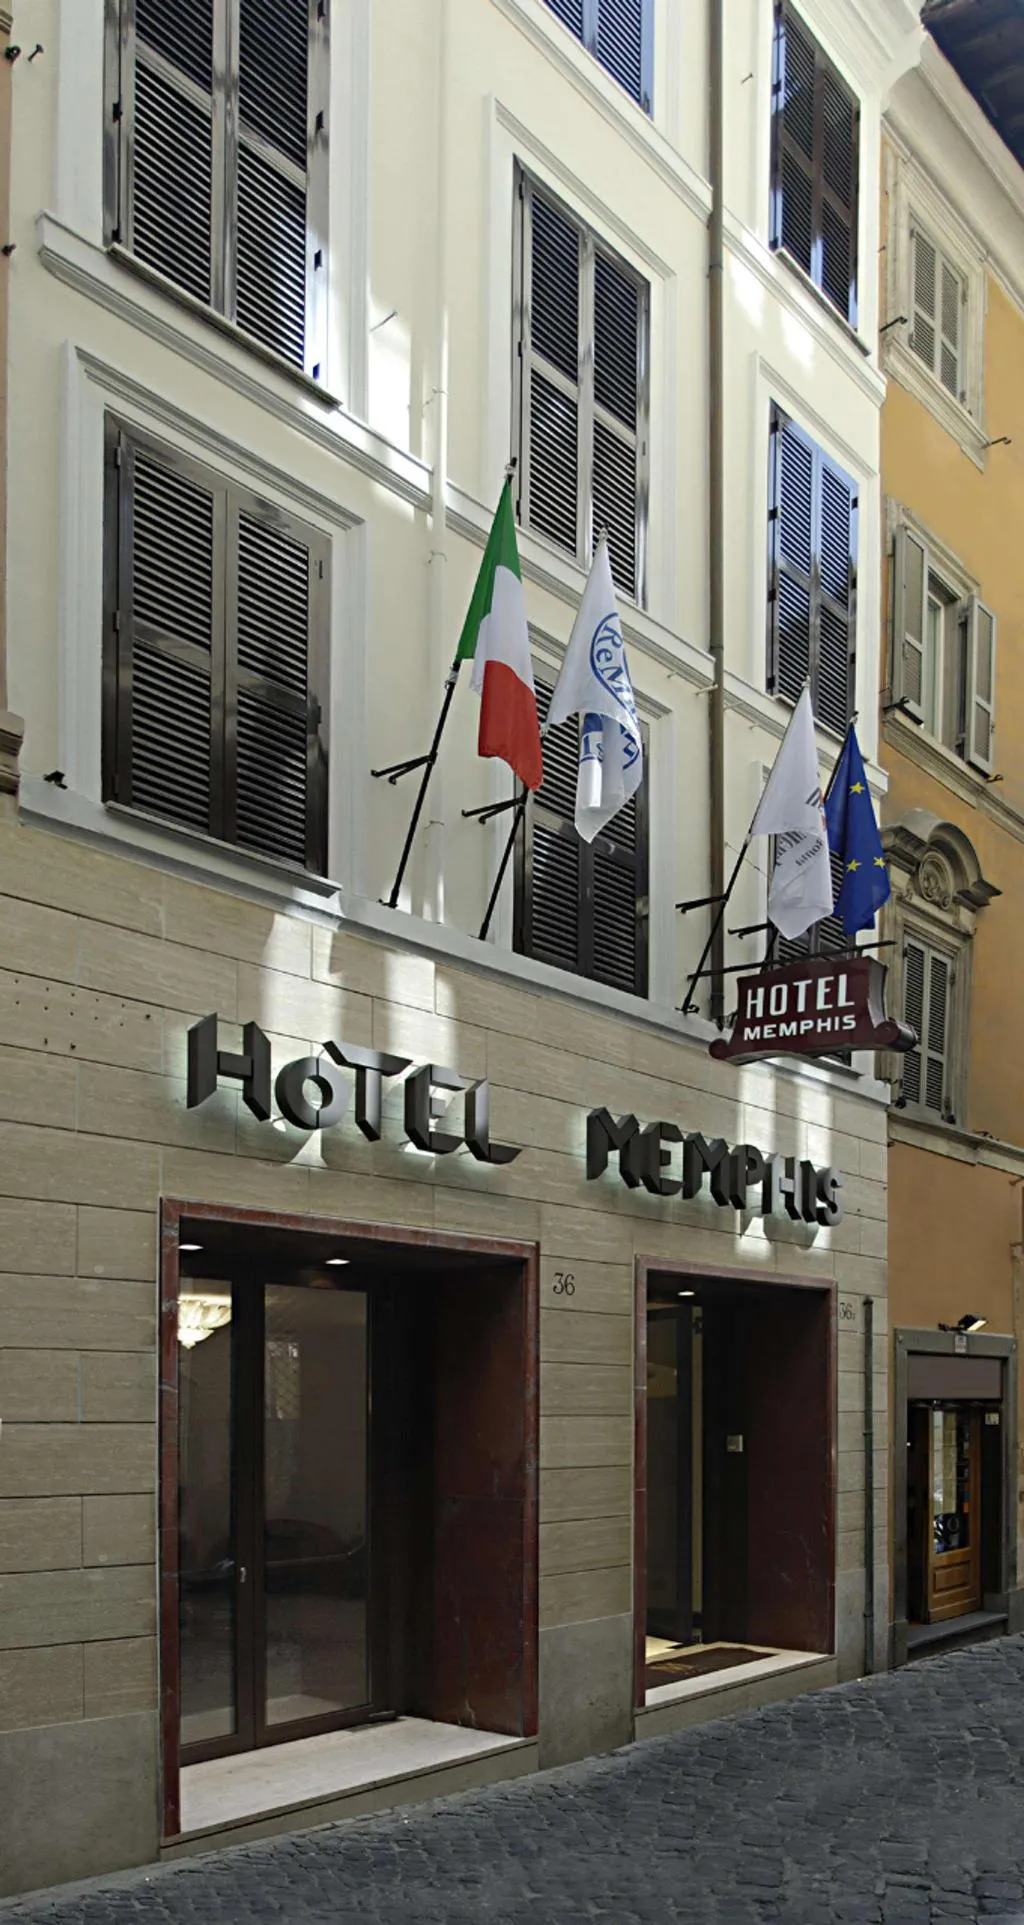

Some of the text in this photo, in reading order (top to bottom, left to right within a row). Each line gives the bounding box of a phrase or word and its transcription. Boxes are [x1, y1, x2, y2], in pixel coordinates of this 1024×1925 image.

[746, 974, 855, 1019] HOTEL
[744, 1015, 857, 1041] MEMPHIS
[186, 1012, 844, 1226] HOTEL MEMPHIS
[553, 1272, 576, 1296] 36
